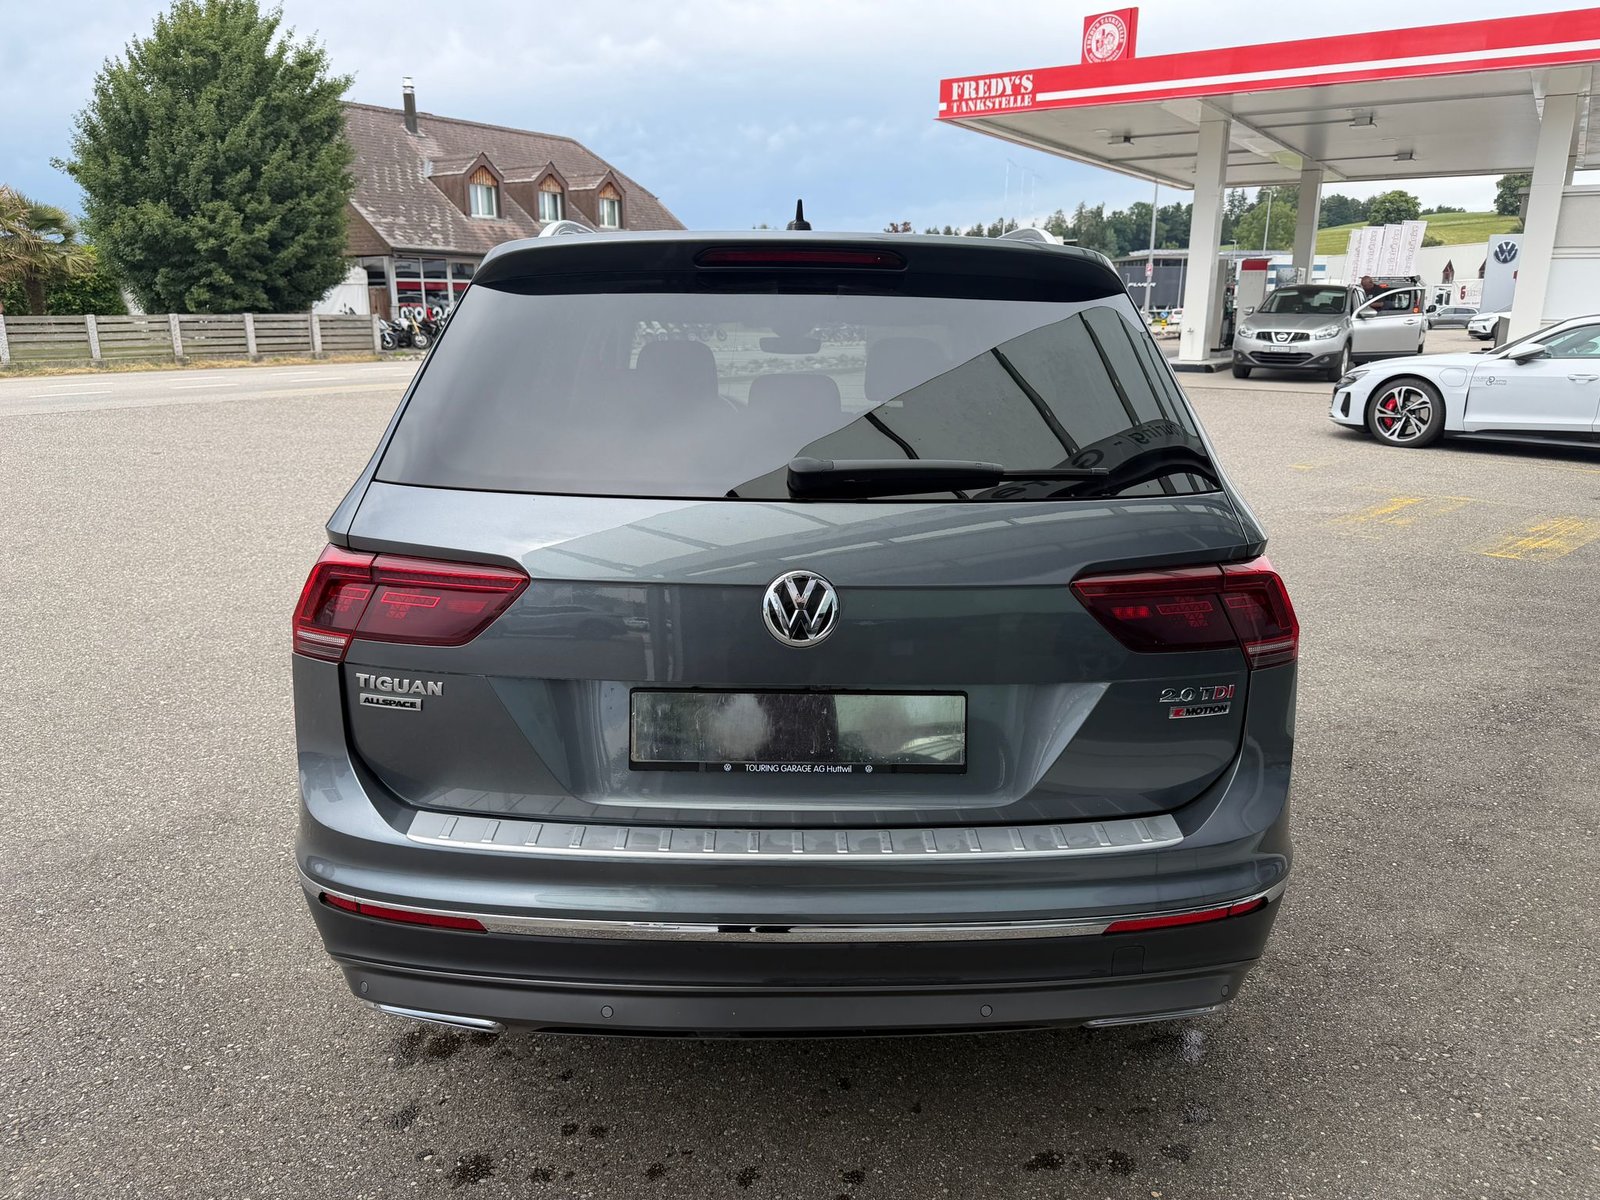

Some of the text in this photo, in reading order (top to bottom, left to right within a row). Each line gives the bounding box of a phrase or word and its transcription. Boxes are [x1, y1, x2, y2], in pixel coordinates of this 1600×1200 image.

[951, 94, 1033, 113] TANKSTELLE
[355, 673, 444, 696] TIGUAN
[1159, 684, 1236, 703] 2.0 TDI
[363, 697, 417, 709] ALLSPACE
[745, 763, 780, 773] TOURING
[780, 763, 812, 773] GARAGE
[813, 764, 826, 773] AG
[826, 764, 853, 773] Huttwil
